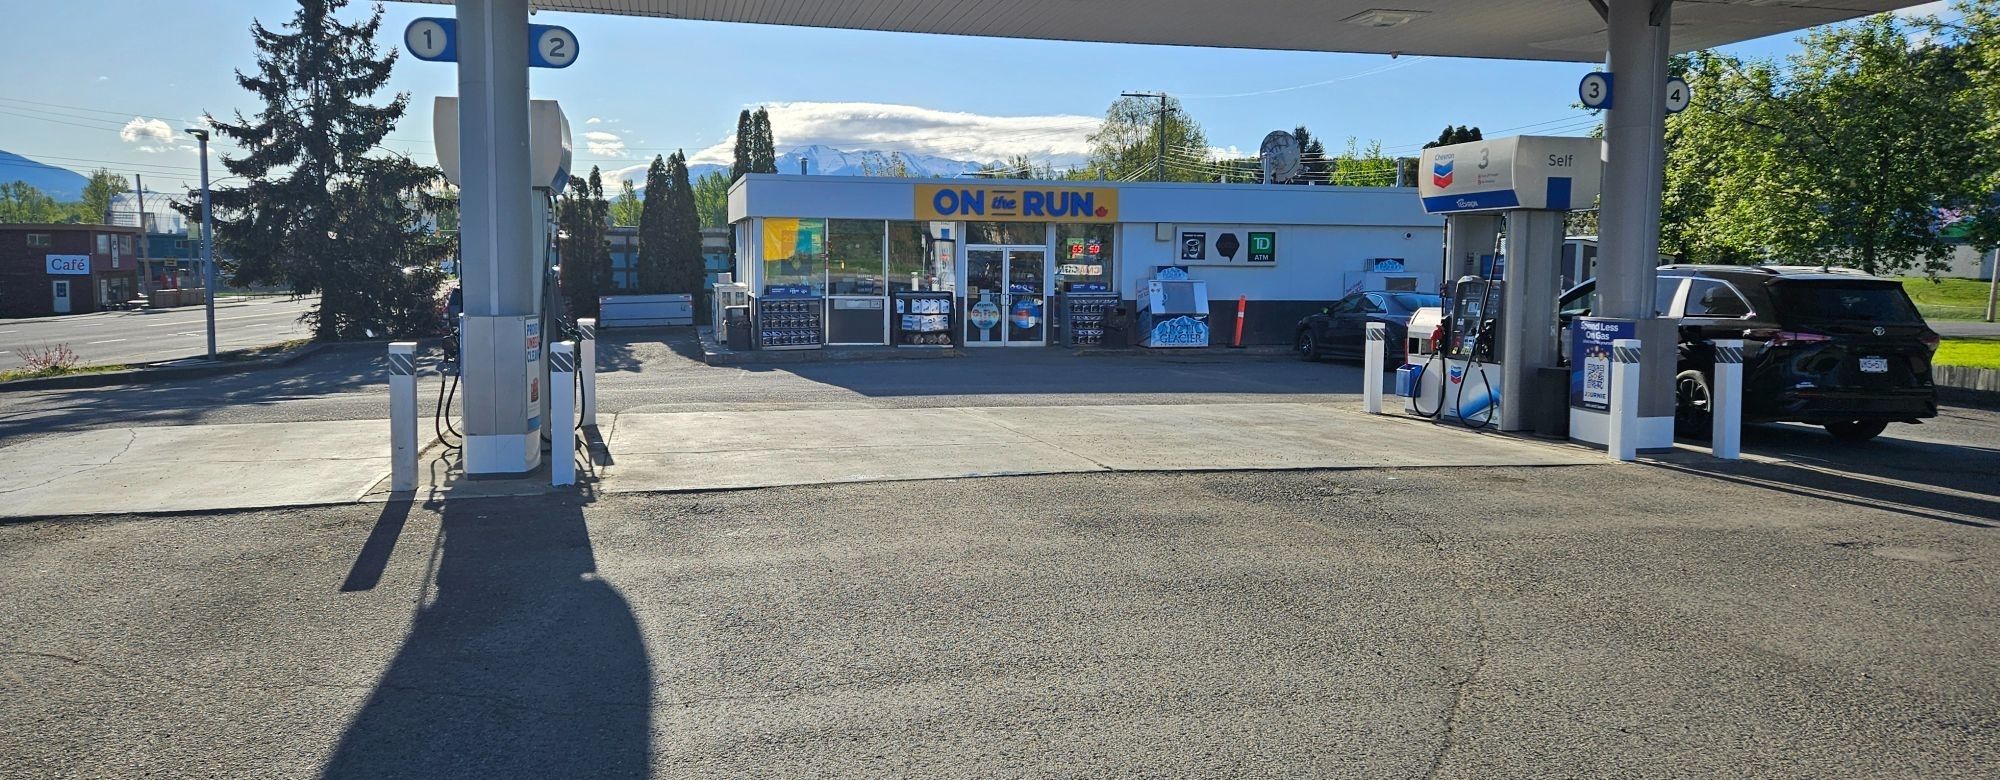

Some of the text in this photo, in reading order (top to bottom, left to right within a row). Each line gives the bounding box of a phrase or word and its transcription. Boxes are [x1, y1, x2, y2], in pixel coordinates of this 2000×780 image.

[423, 29, 432, 50] 1
[549, 37, 566, 58] 2
[1588, 81, 1600, 99] 3
[1670, 88, 1681, 103] 4
[1478, 147, 1489, 170] 3
[1547, 153, 1573, 168] Self
[932, 188, 1095, 217] ON the RUN
[1253, 237, 1271, 250] TD
[51, 258, 85, 270] Café
[1160, 323, 1204, 335] ARCTIC
[1580, 321, 1619, 332] Spend Less
[1159, 333, 1202, 343] GLACIER
[1586, 331, 1610, 341] On Gas
